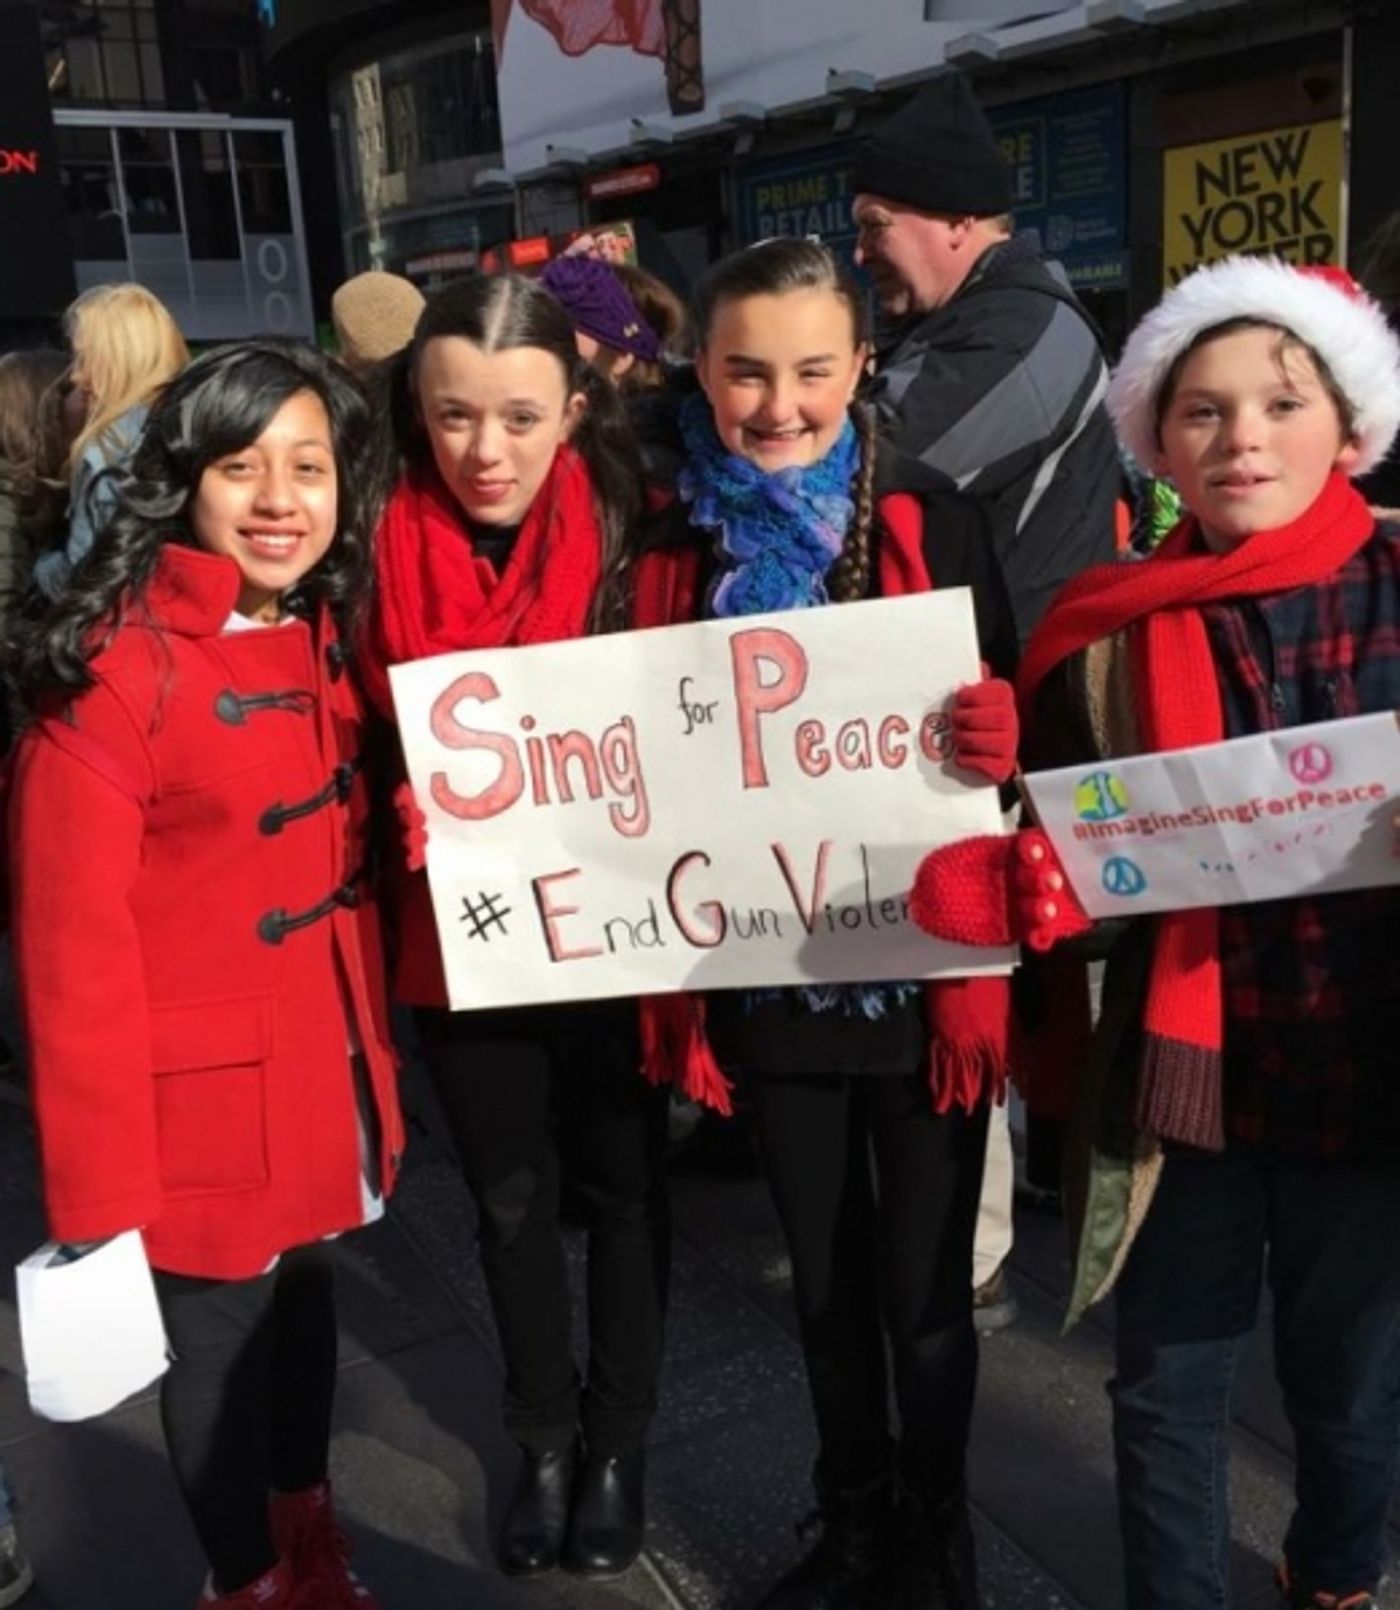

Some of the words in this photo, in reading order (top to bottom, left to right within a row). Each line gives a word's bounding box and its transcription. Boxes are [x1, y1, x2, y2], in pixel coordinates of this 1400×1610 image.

[757, 175, 827, 212] PRIME
[1196, 129, 1311, 206] NEW
[759, 201, 849, 239] RETAIL
[1180, 180, 1327, 257] YORK
[430, 671, 651, 838] Sing
[677, 676, 719, 736] for
[729, 627, 957, 789] Peace
[1072, 782, 1386, 841] #ImagineSingForPeace
